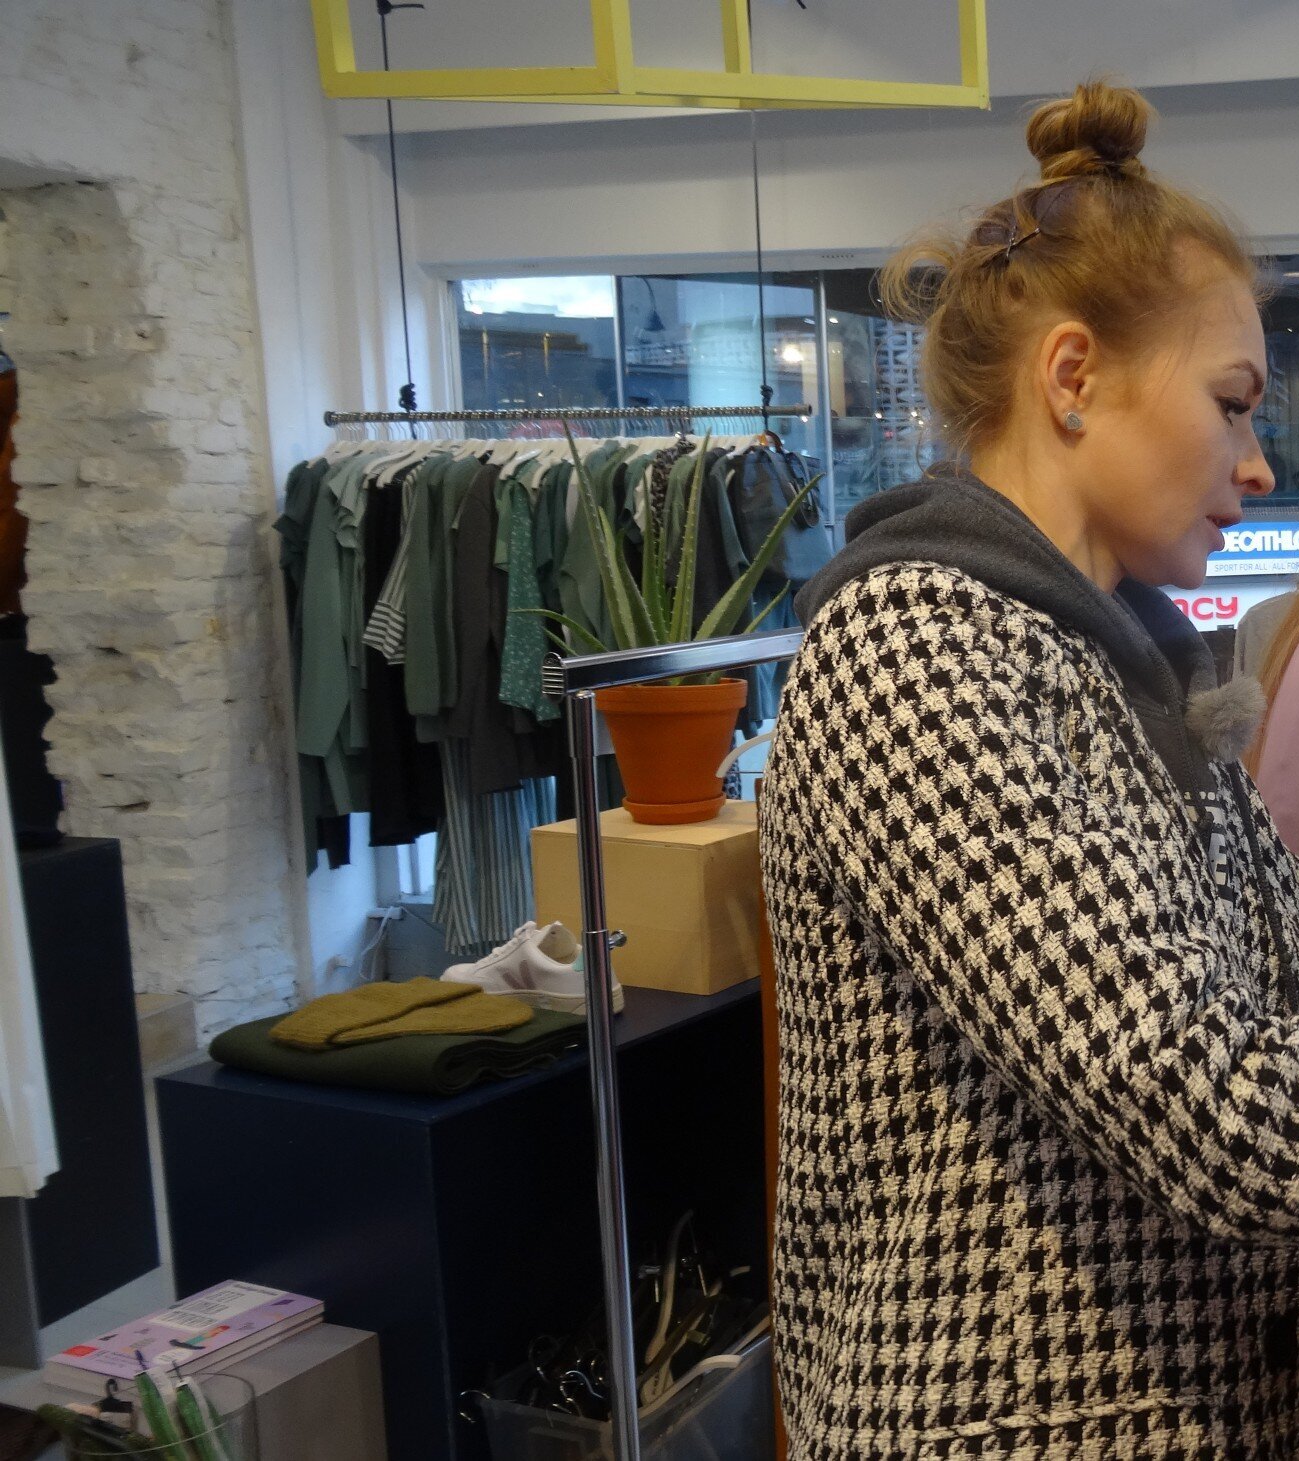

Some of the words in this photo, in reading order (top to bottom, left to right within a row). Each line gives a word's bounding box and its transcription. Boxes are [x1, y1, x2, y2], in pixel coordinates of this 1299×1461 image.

[1214, 563, 1238, 572] SPORT
[1239, 563, 1253, 571] FOR
[1254, 562, 1268, 571] ALL
[1272, 562, 1286, 570] ALL
